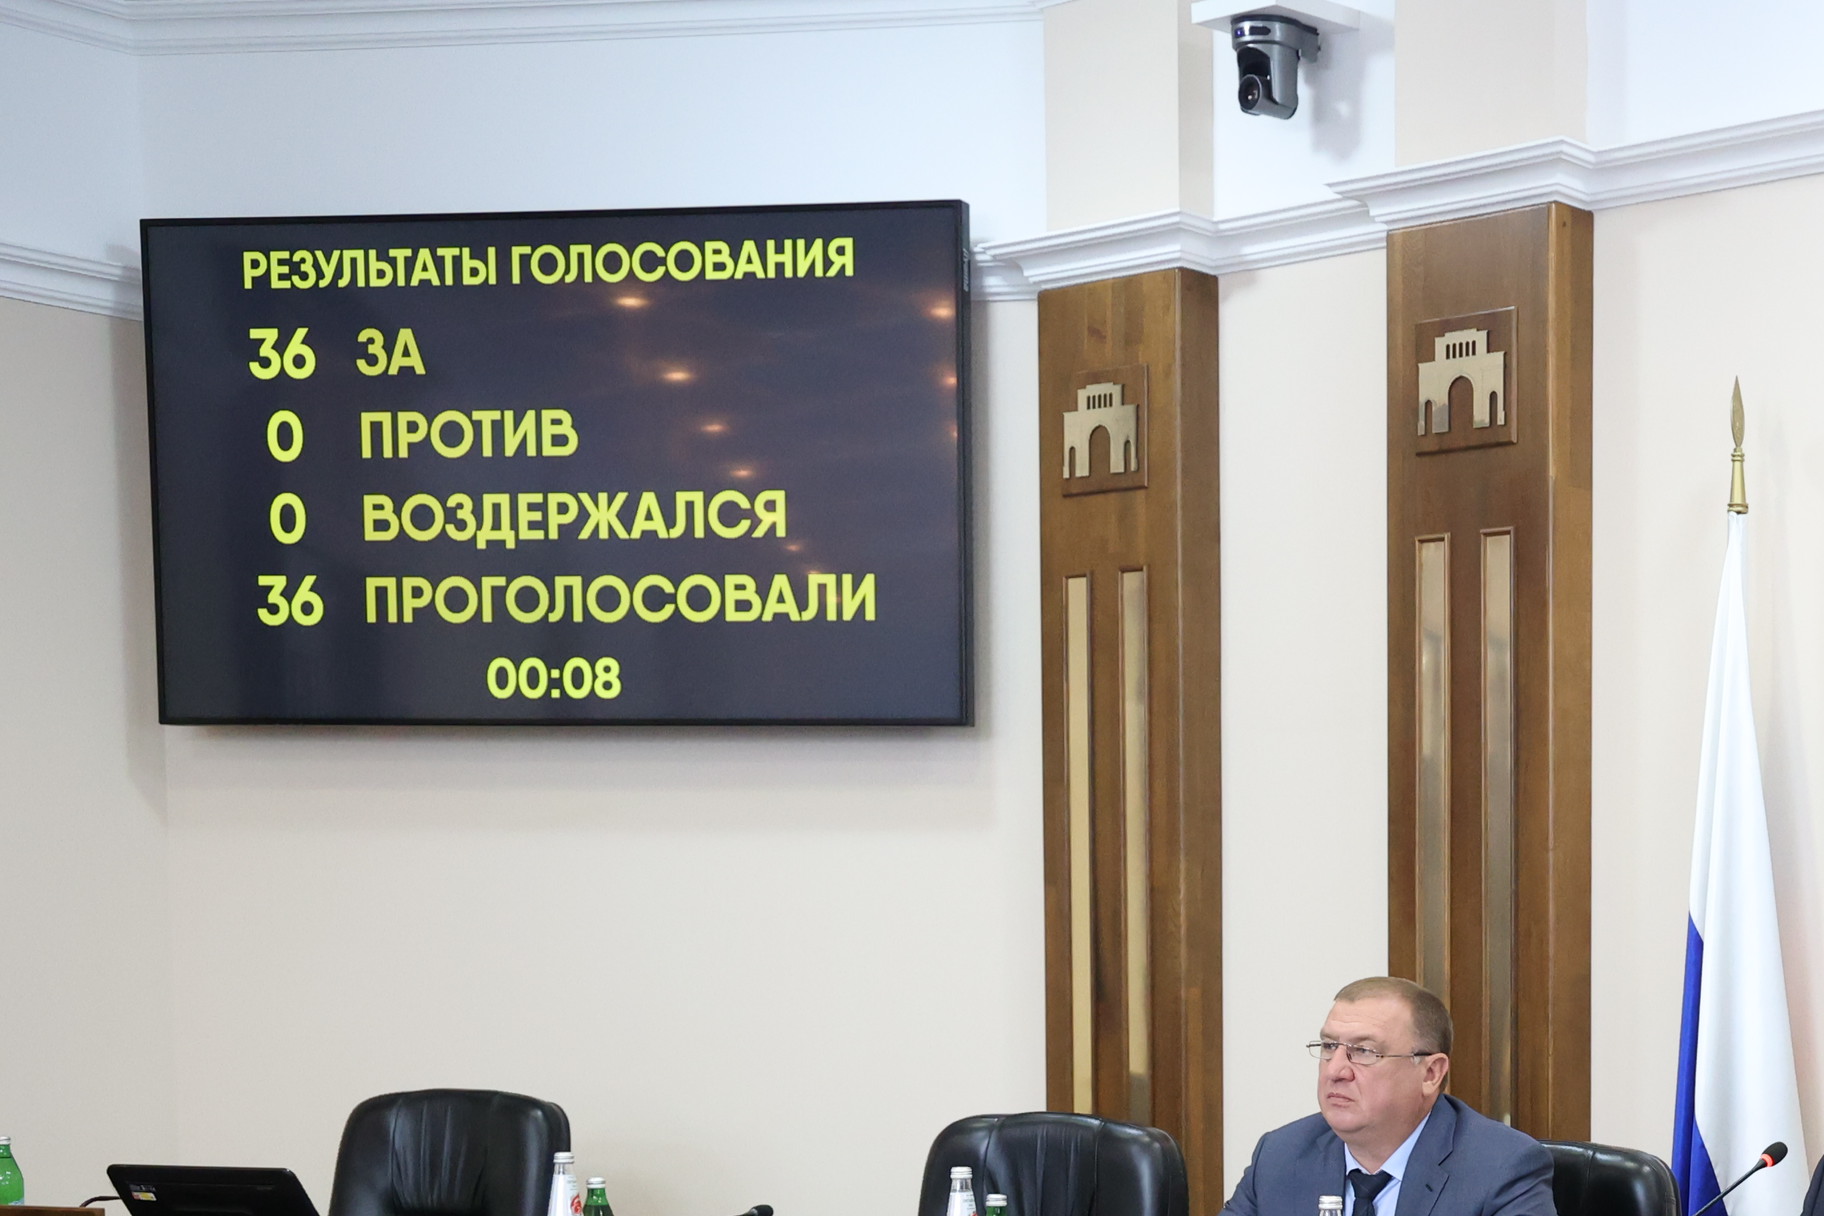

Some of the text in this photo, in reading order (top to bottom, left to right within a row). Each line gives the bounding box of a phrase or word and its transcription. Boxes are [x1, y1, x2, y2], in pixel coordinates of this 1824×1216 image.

[243, 237, 854, 289] РЕЗУЛЬТАТЫ ГОЛОСОВАНИЯ
[248, 327, 426, 380] 36 ЗА
[266, 408, 579, 463] 0 ПРОТИВ
[269, 489, 787, 549] 0 ВОЗДЕРЖАЛСЯ
[257, 573, 876, 626] 36 ПРОГОЛОСОВАЛИ
[486, 656, 622, 699] 00:08
